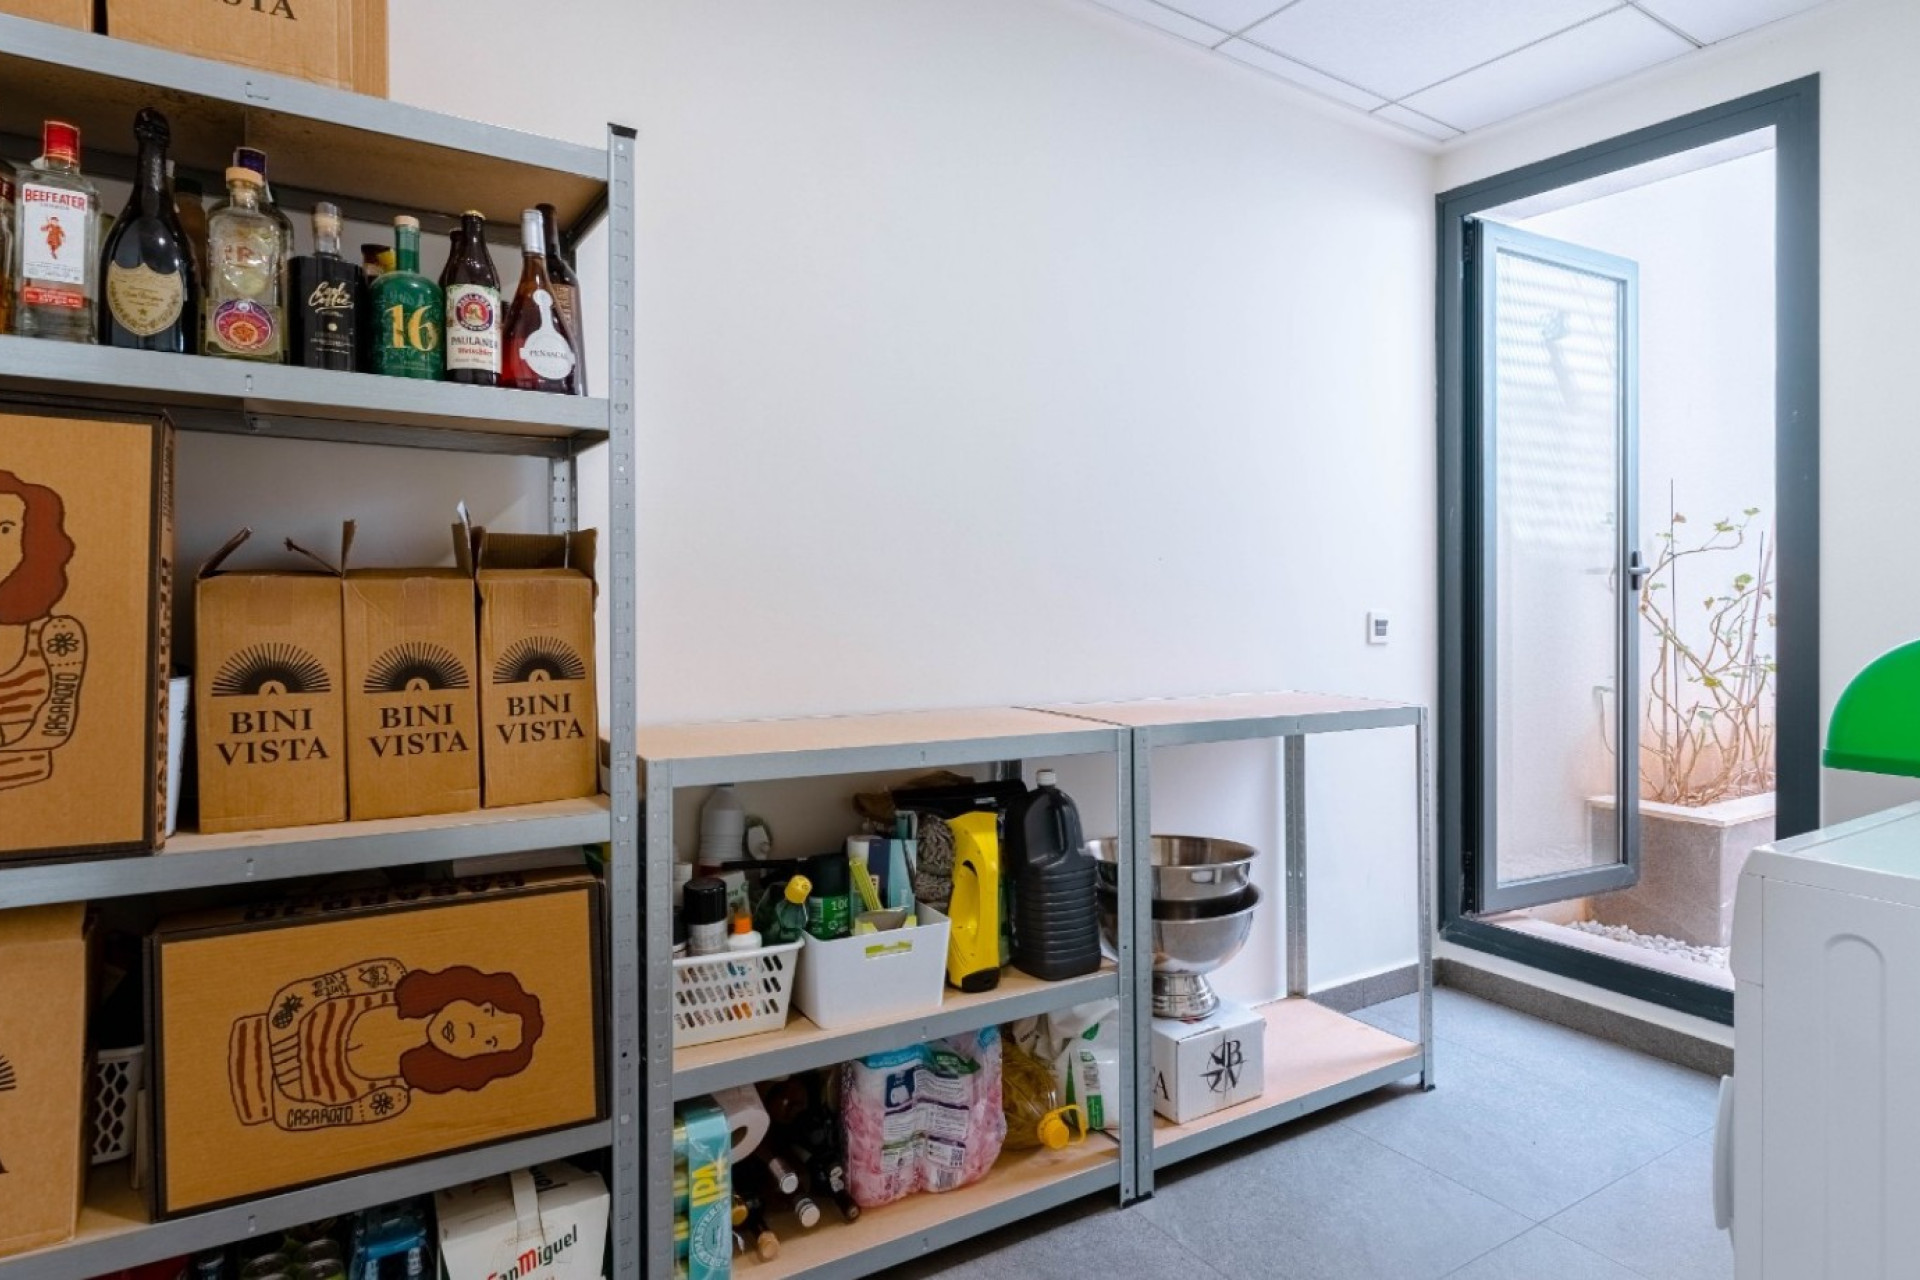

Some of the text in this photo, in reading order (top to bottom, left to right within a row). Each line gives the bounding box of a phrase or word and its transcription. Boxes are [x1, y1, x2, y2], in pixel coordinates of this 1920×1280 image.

[25, 189, 85, 211] BEEFEATER
[385, 304, 438, 351] 16
[41, 672, 80, 737] CASAROJO
[379, 703, 454, 729] BINI
[507, 693, 571, 716] BINI
[229, 708, 312, 734] BINI
[496, 718, 585, 744] VISTA
[216, 736, 330, 766] VISTA
[368, 730, 469, 757] VISTA
[287, 1106, 353, 1128] CASAROJO
[692, 1158, 728, 1207] IPA
